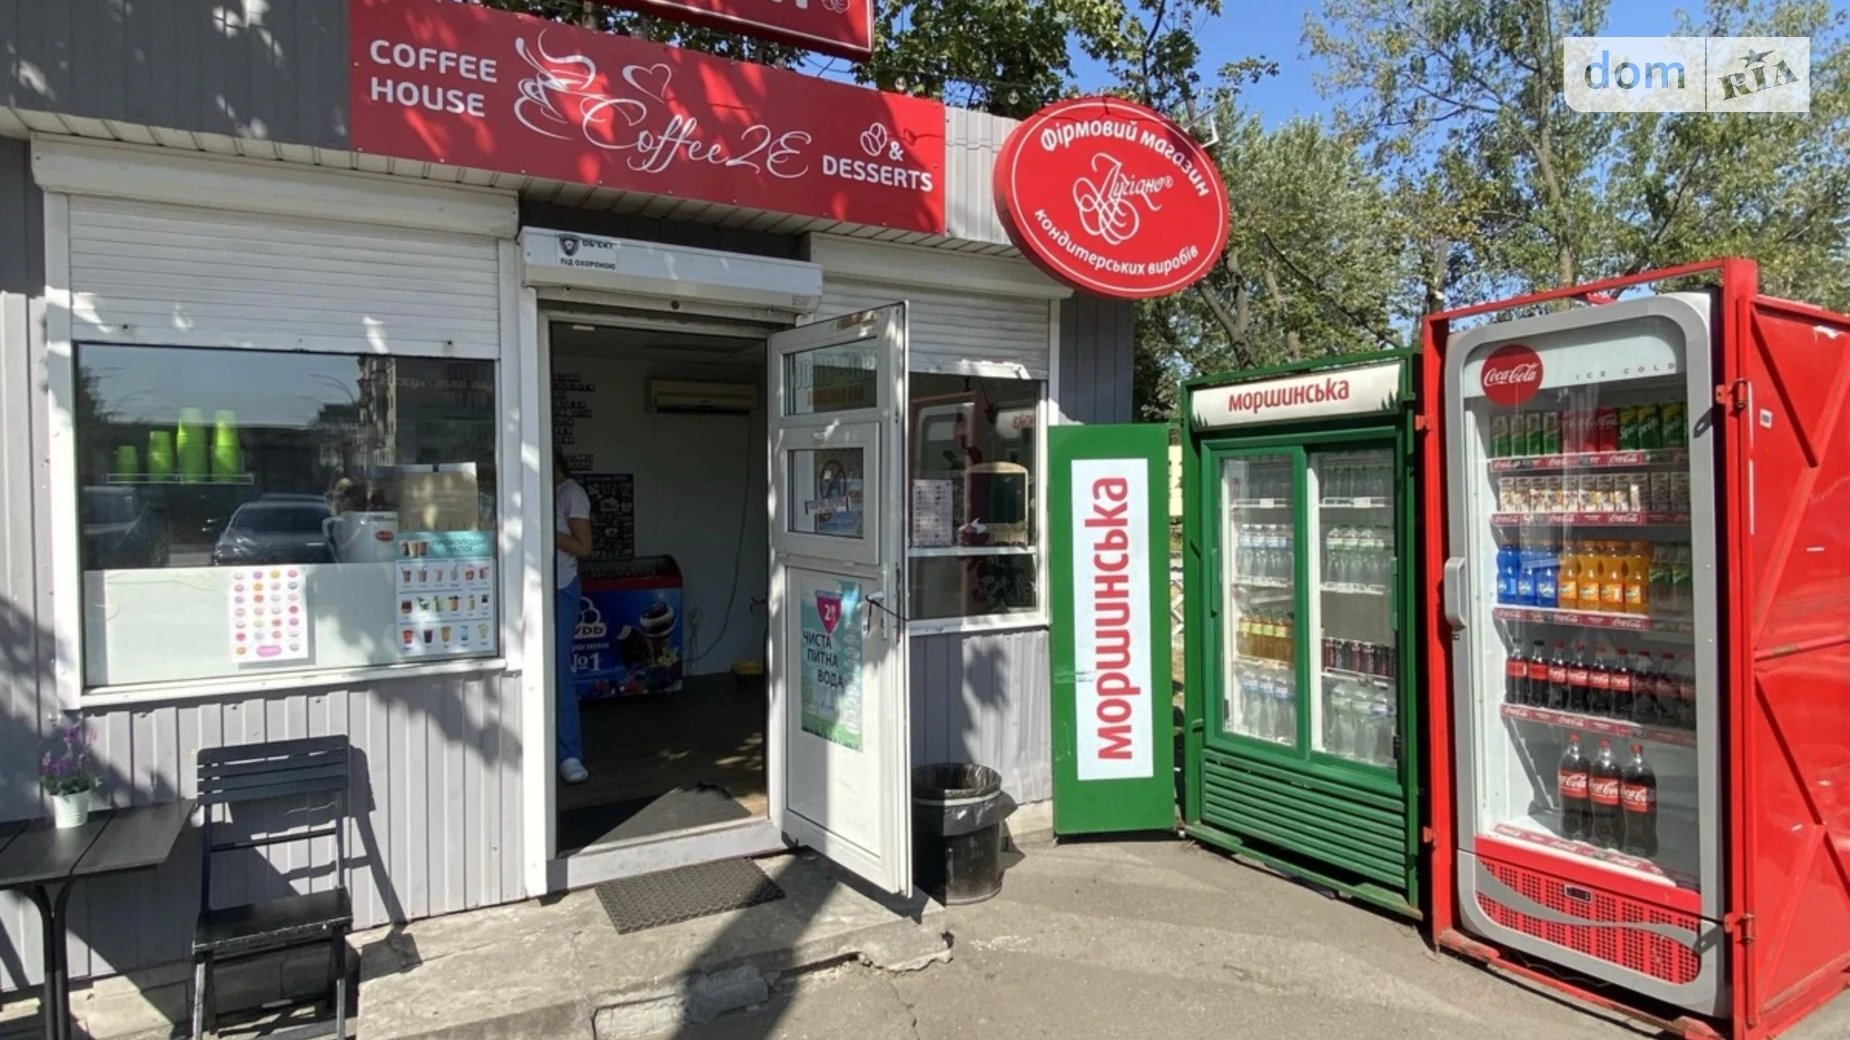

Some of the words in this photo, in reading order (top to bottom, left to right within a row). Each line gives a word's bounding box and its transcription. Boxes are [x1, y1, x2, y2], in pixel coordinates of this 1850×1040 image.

[369, 39, 498, 83] COFFEE
[369, 77, 487, 118] HOUSE
[889, 140, 904, 161] &
[1040, 119, 1138, 153] Фірмовий
[1140, 130, 1210, 198] магазин
[822, 155, 934, 193] DESSERTS
[1033, 208, 1146, 276] кондитерських
[1148, 244, 1200, 277] виробів
[1575, 369, 1607, 380] ICE
[1622, 361, 1676, 375] COLD
[1227, 377, 1351, 414] моршинська
[1084, 476, 1142, 761] моршинська
[802, 630, 833, 650] ЧИСТА
[807, 648, 840, 669] ПИТНА
[816, 669, 845, 690] ВОДА
